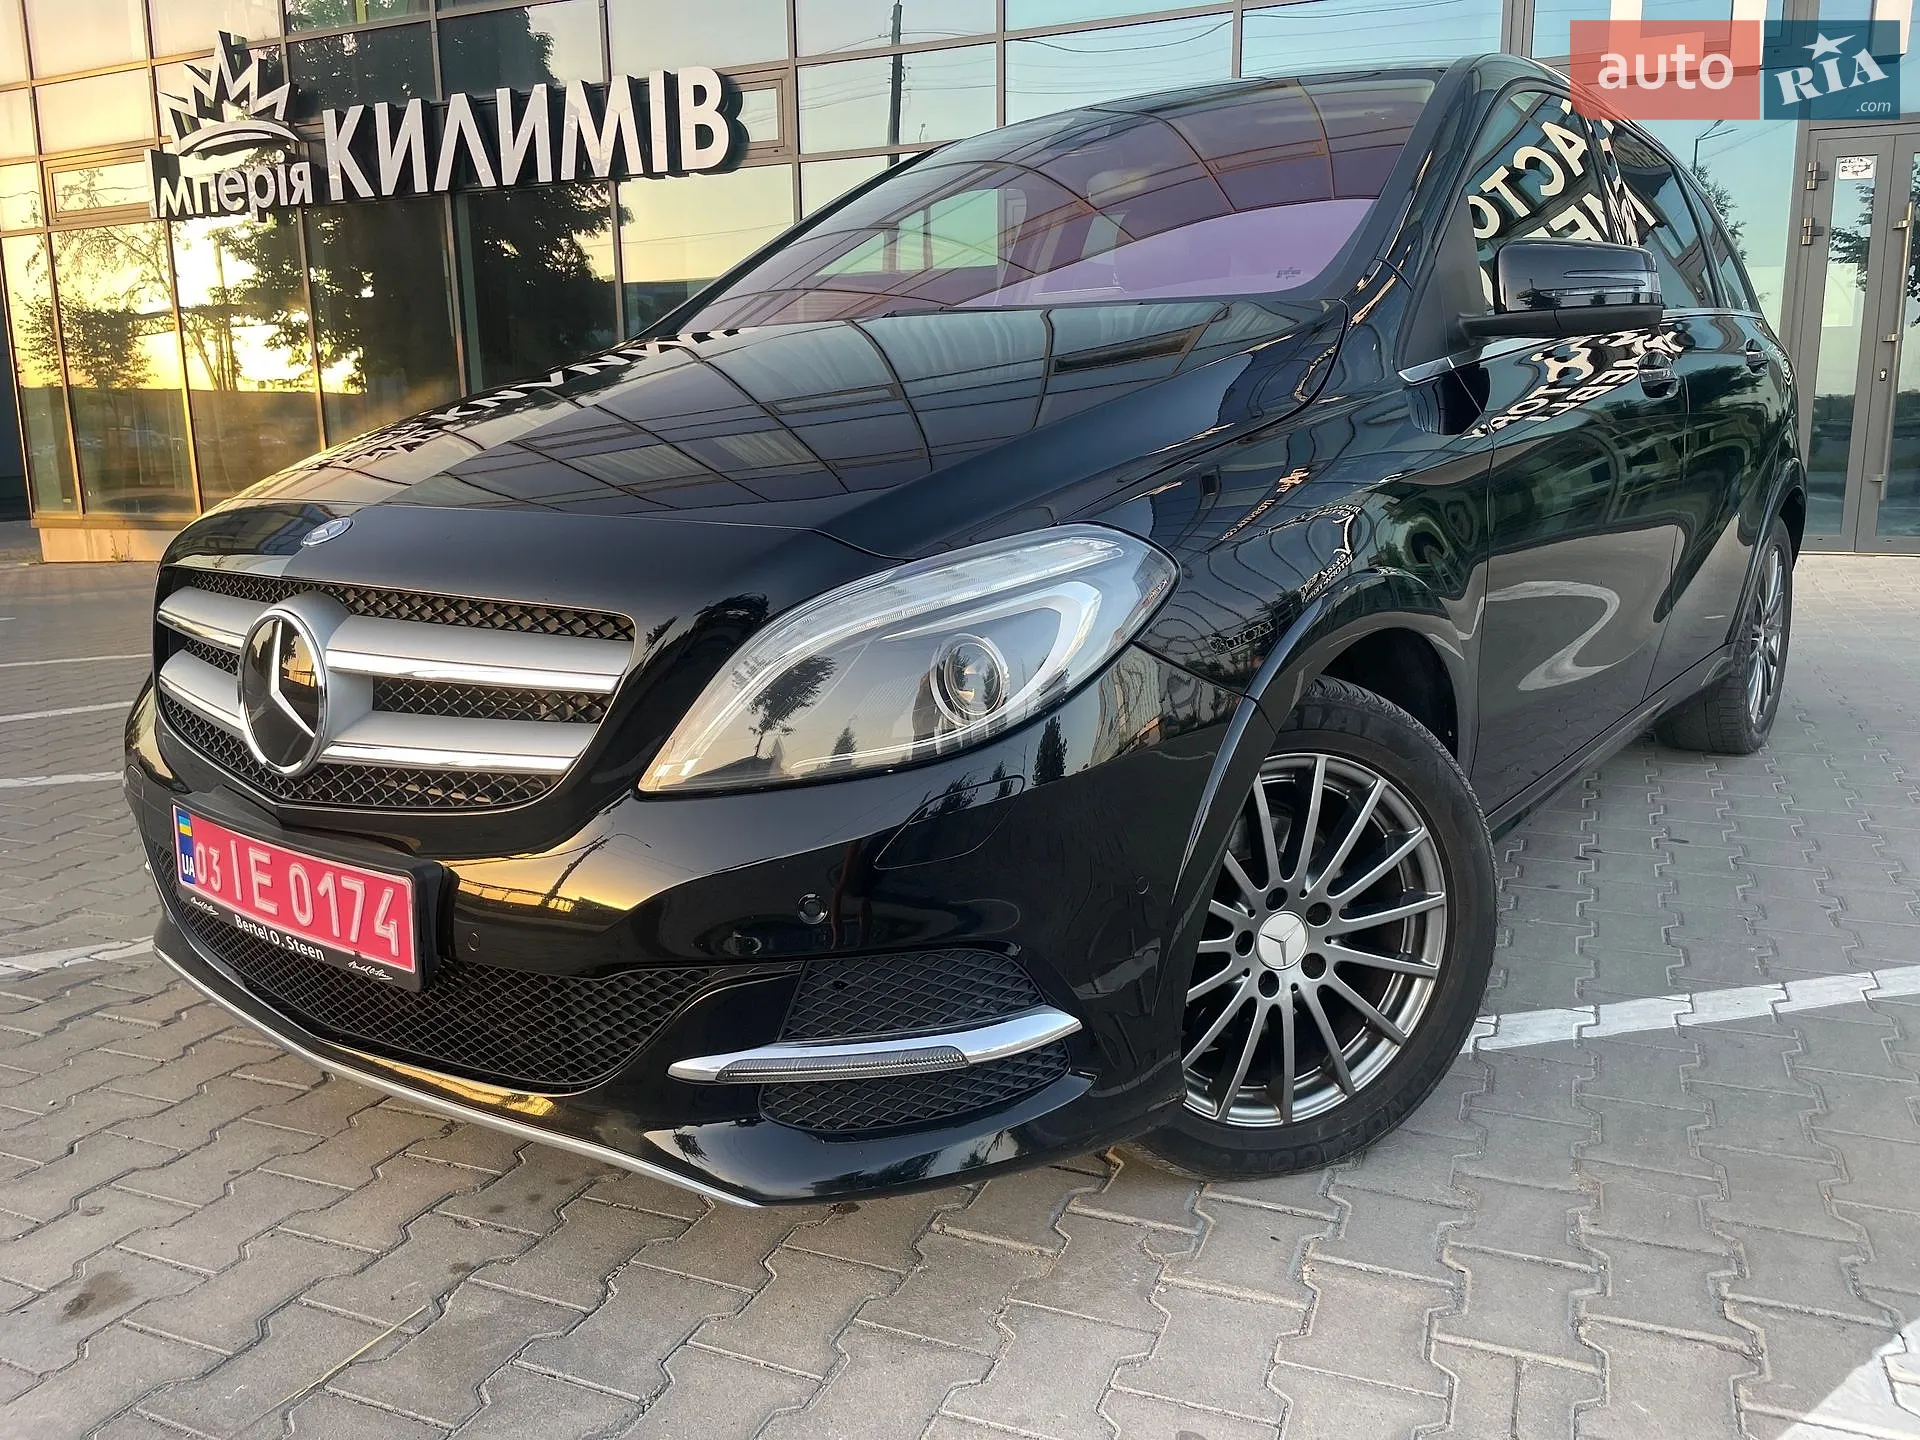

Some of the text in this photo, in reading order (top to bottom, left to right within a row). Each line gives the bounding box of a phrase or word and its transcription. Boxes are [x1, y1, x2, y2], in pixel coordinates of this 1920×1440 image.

[323, 66, 731, 201] КИЛИМІВ
[181, 853, 196, 878] UA
[195, 842, 222, 892] 03
[288, 862, 400, 957] 0174
[234, 913, 269, 941] Bertel
[286, 935, 326, 962] Steen
